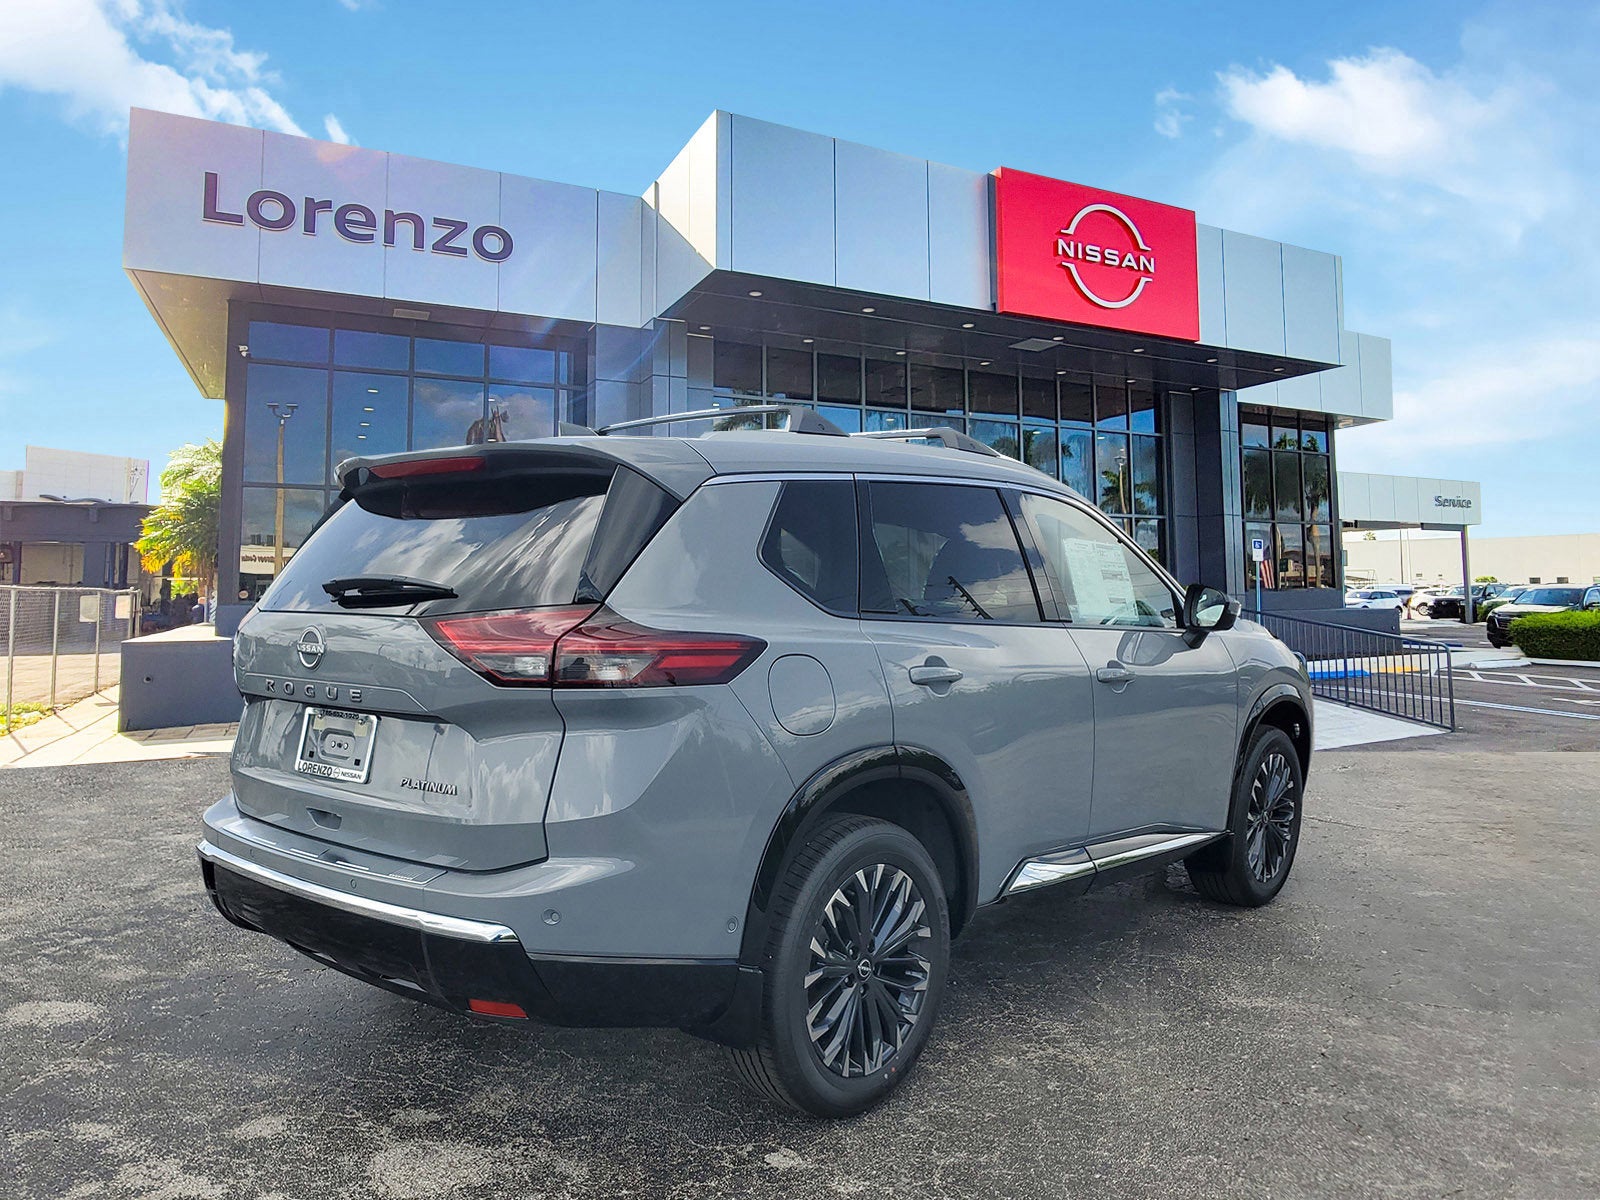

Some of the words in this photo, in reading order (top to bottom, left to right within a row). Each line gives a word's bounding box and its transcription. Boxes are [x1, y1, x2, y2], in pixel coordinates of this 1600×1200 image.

[202, 170, 515, 262] Lorenzo
[1056, 238, 1156, 274] NISSAN
[1434, 495, 1472, 508] Service
[265, 679, 363, 703] ROGUE
[298, 760, 333, 777] LORENZO
[340, 771, 363, 780] NISSAN
[400, 777, 458, 796] PLATINUM
